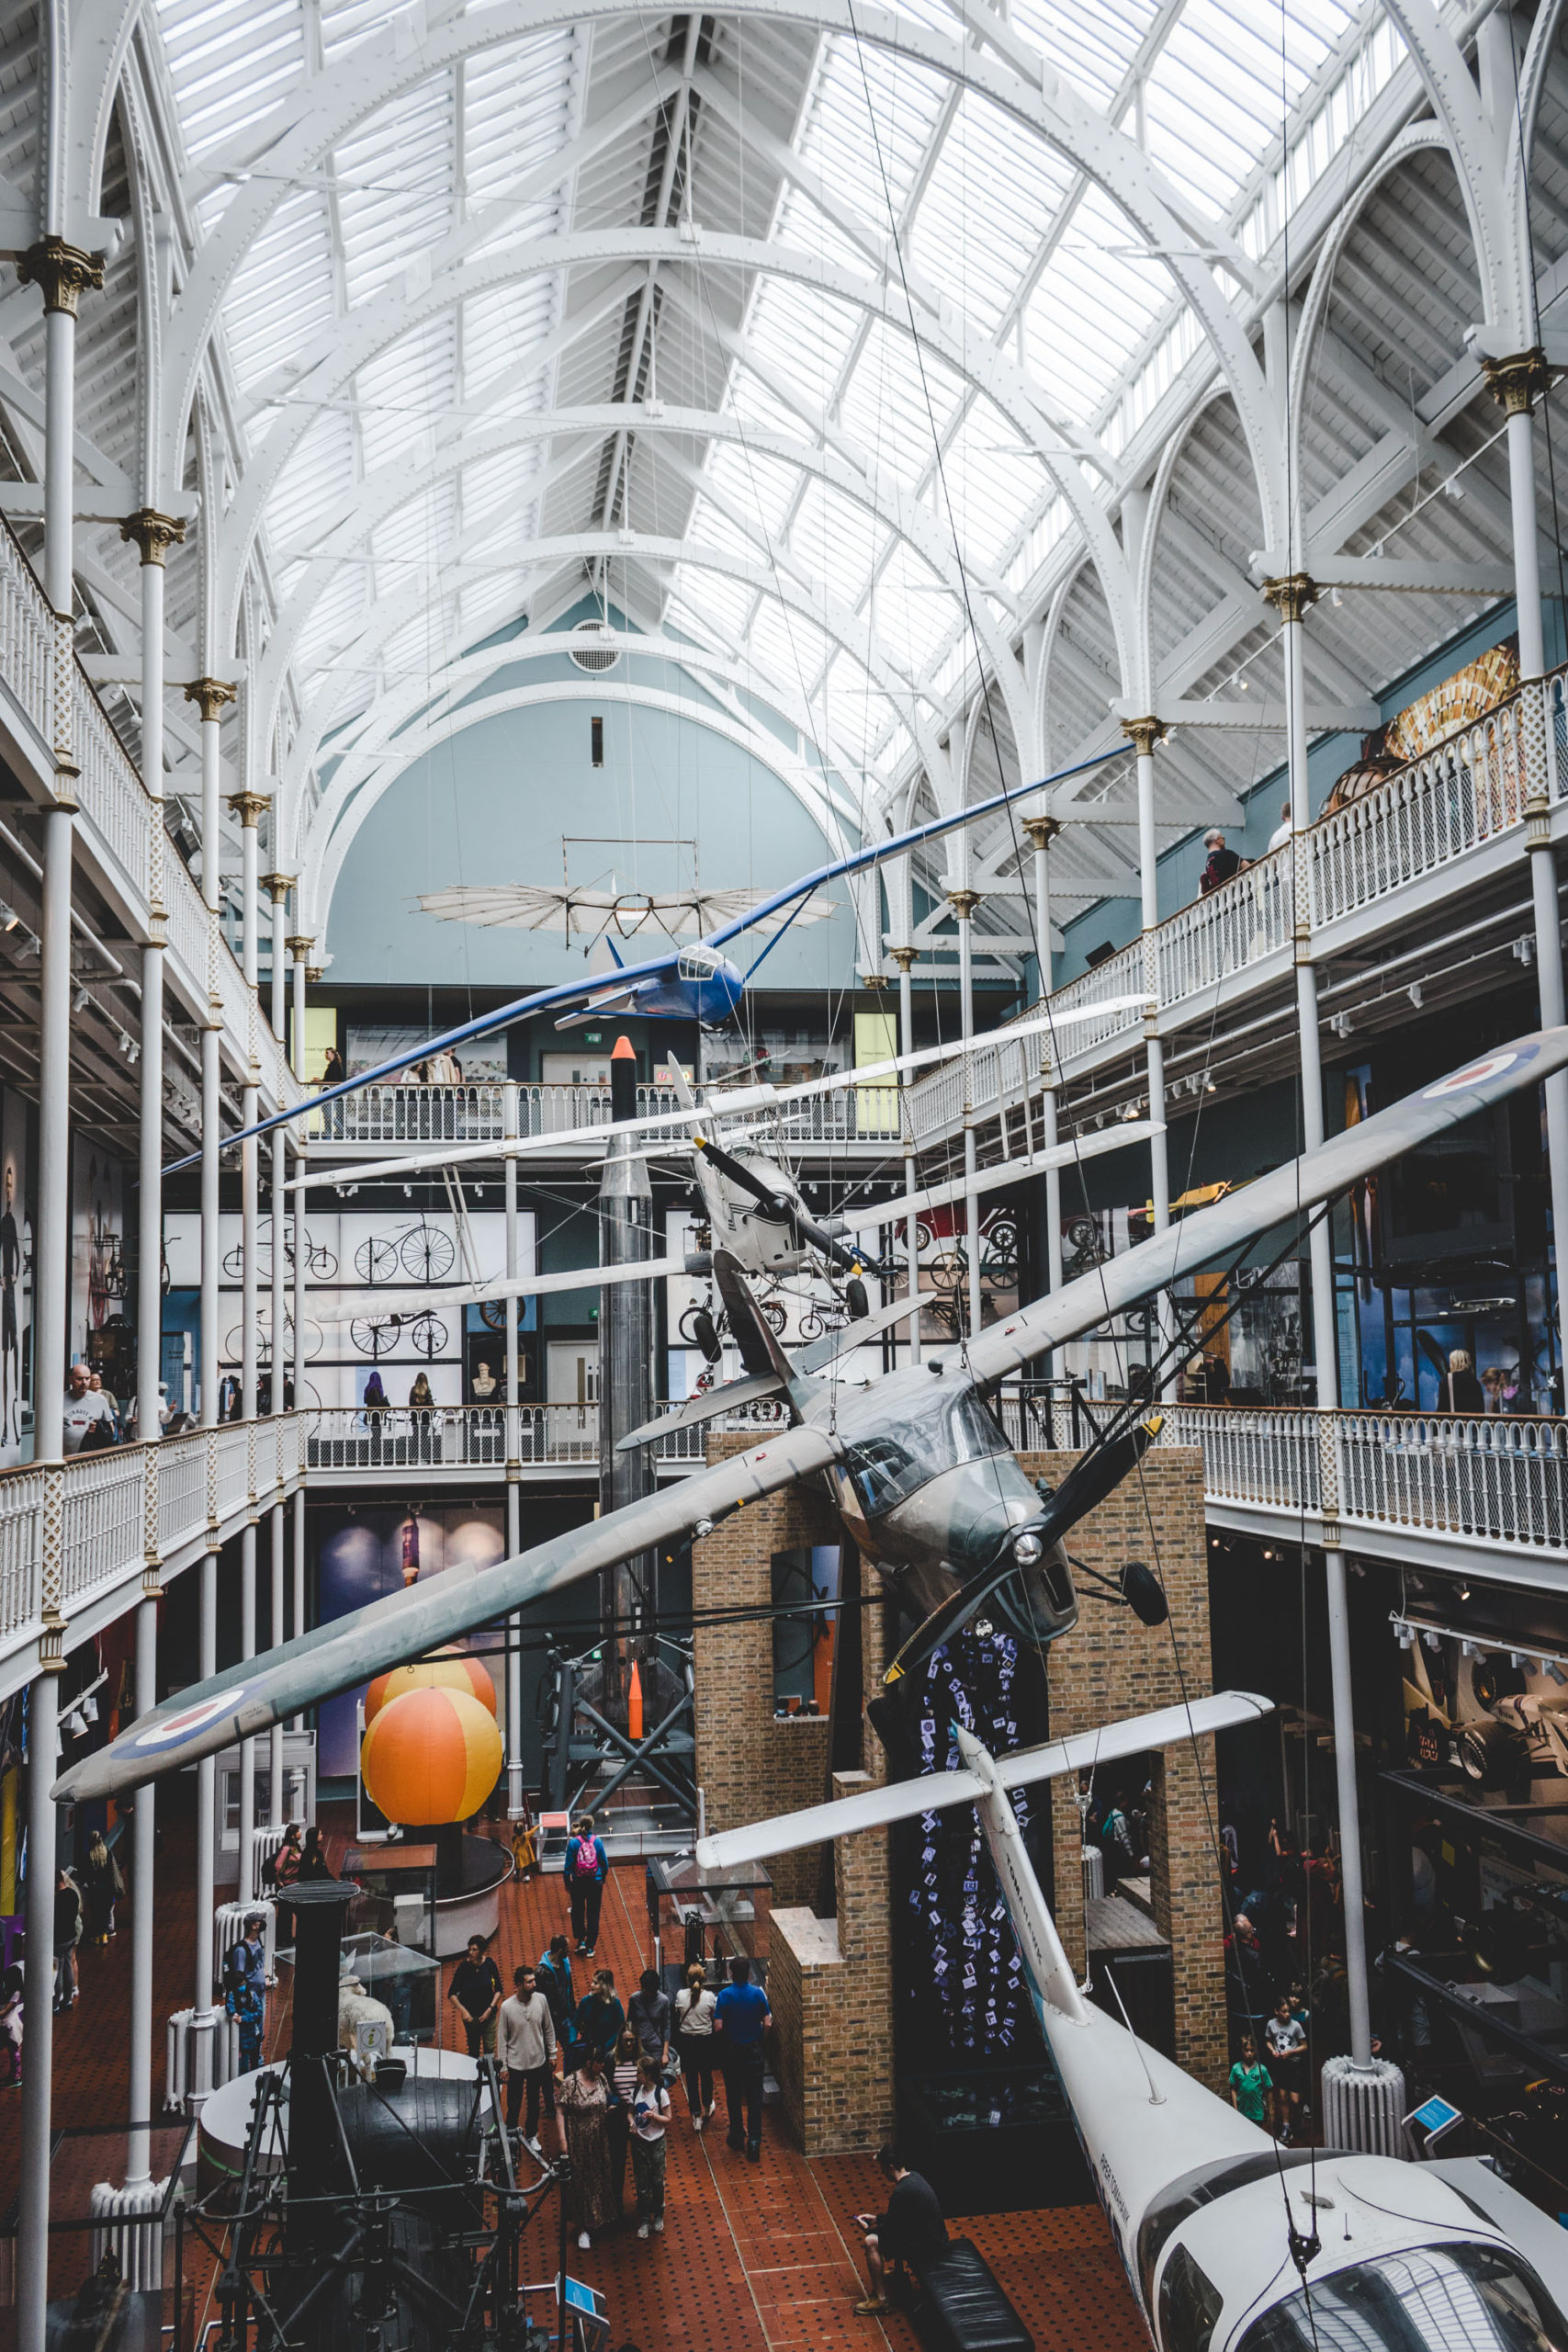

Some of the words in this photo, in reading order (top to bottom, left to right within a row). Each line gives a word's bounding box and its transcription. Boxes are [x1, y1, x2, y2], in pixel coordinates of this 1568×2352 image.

[1006, 1853, 1043, 1965] TOMAHAWK
[1100, 2153, 1112, 2184] PIPER
[1110, 2174, 1131, 2227] TOMAHAWK
